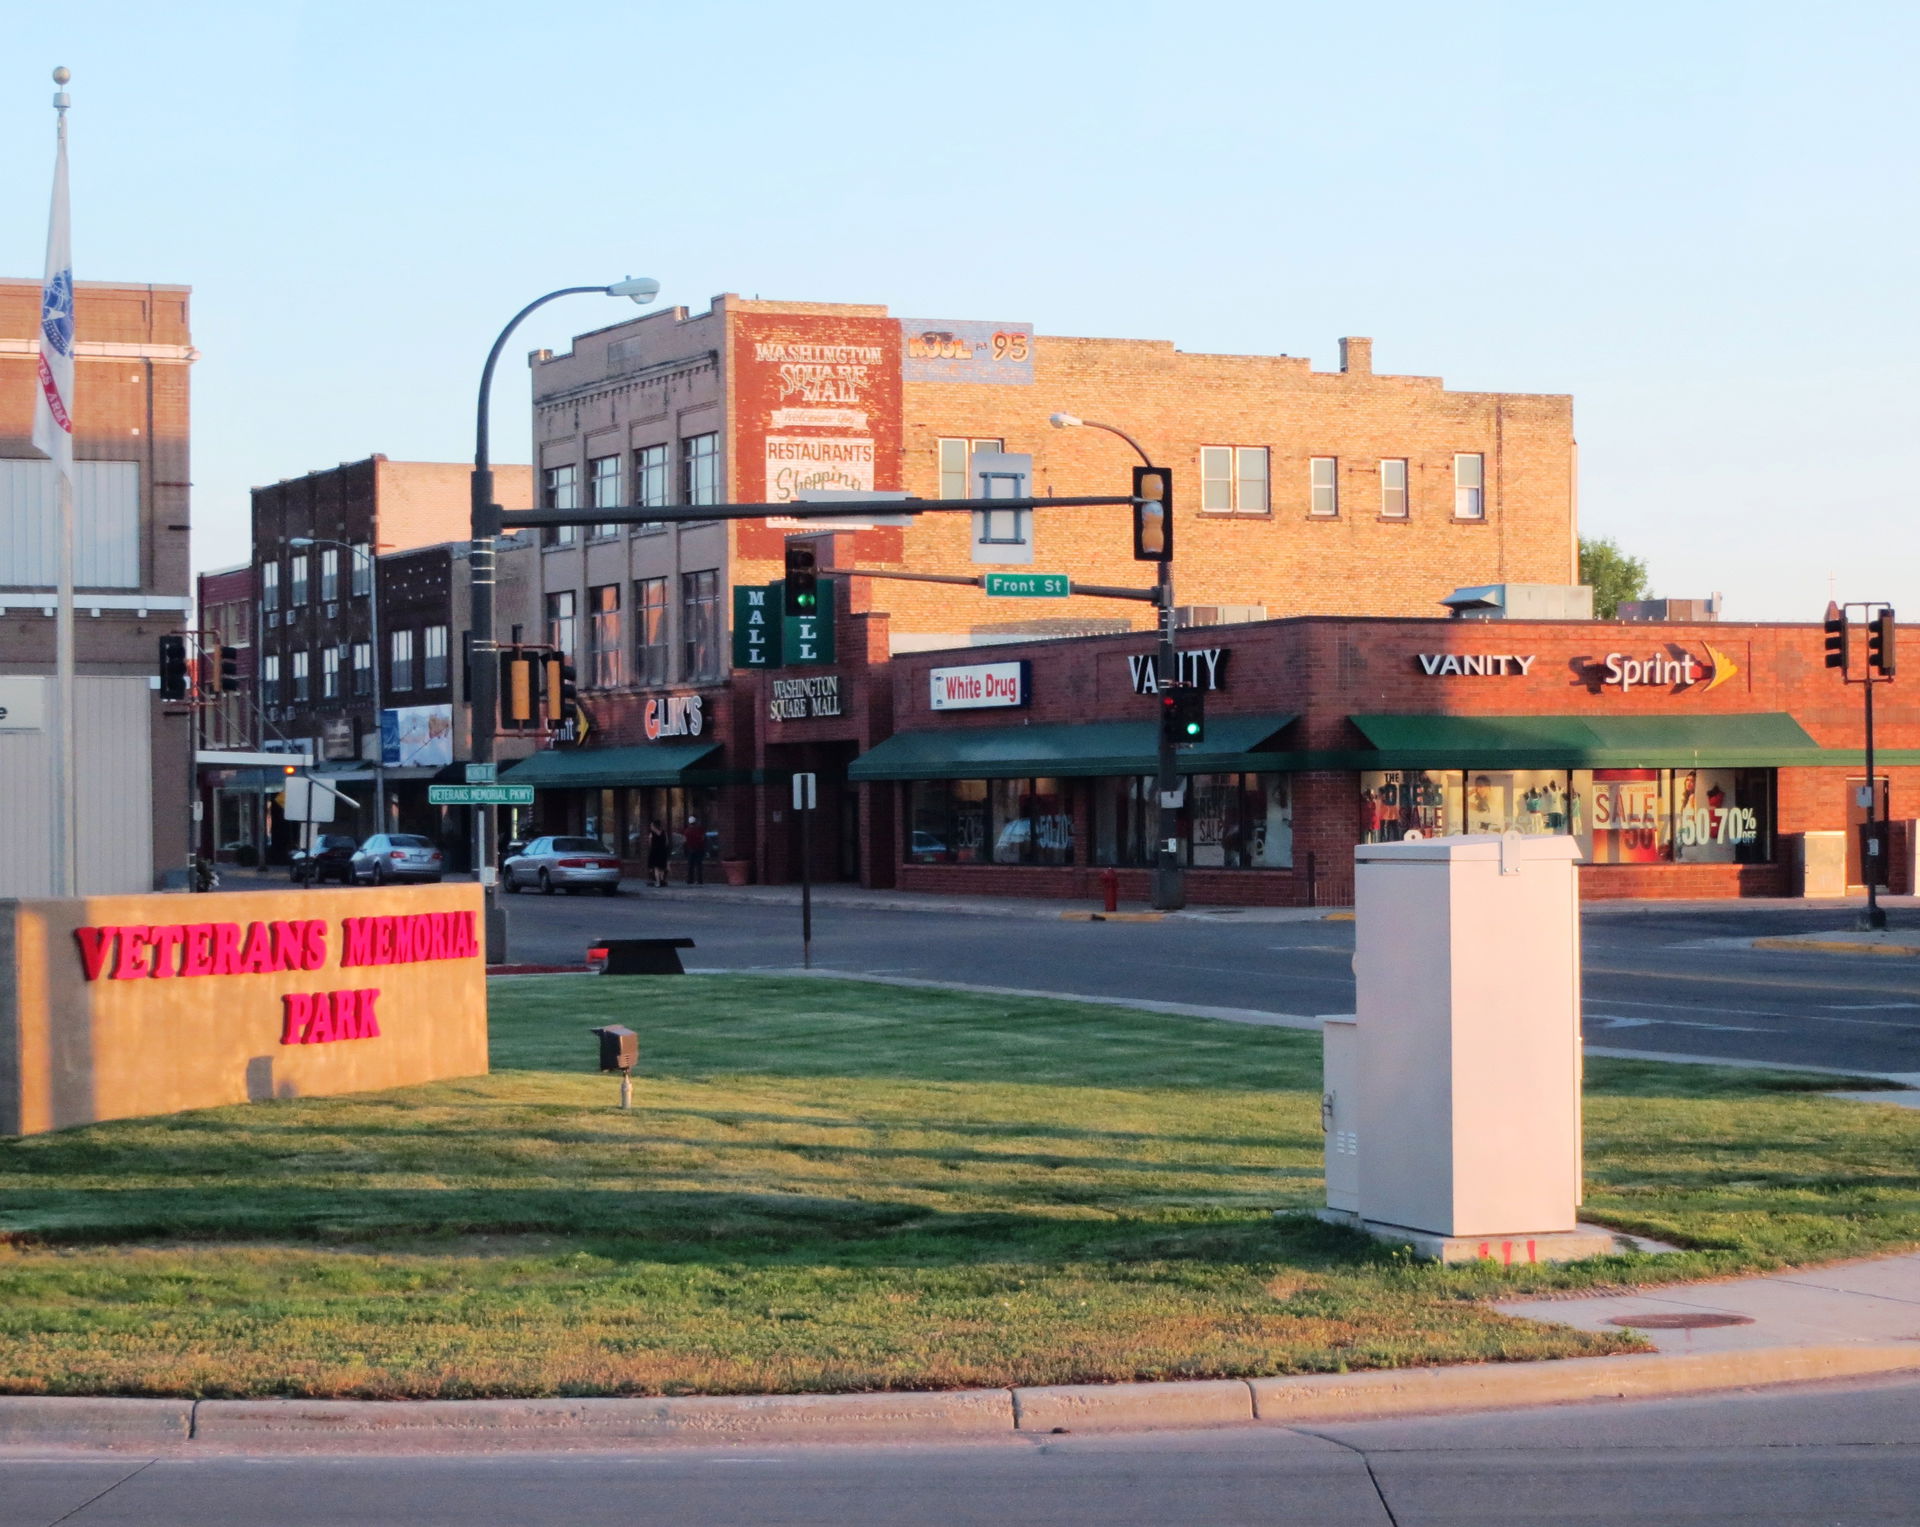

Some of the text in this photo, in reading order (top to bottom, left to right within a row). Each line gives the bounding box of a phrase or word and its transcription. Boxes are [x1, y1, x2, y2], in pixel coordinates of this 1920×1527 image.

[754, 343, 883, 365] WASHINGTON
[908, 337, 972, 360] KOOL
[991, 330, 1029, 361] 95
[779, 364, 869, 402] SQUARE
[801, 380, 860, 402] MALL
[768, 442, 872, 462] RESTAURANTS
[993, 578, 1061, 592] Front St
[748, 591, 766, 663] MALL
[1127, 648, 1221, 695] VAITY
[1418, 654, 1536, 676] VANITY
[1605, 653, 1695, 692] Sprint
[773, 676, 838, 699] WASHINGTON
[945, 673, 1017, 703] White Drug
[770, 695, 841, 722] SQUARE MALL
[1384, 772, 1400, 783] THE
[431, 788, 532, 801] VETERANS MEMORIAL PKWY
[1595, 793, 1656, 823] SALE
[74, 910, 479, 981] VETERANS MEMORIAL
[280, 988, 381, 1045] PARK
